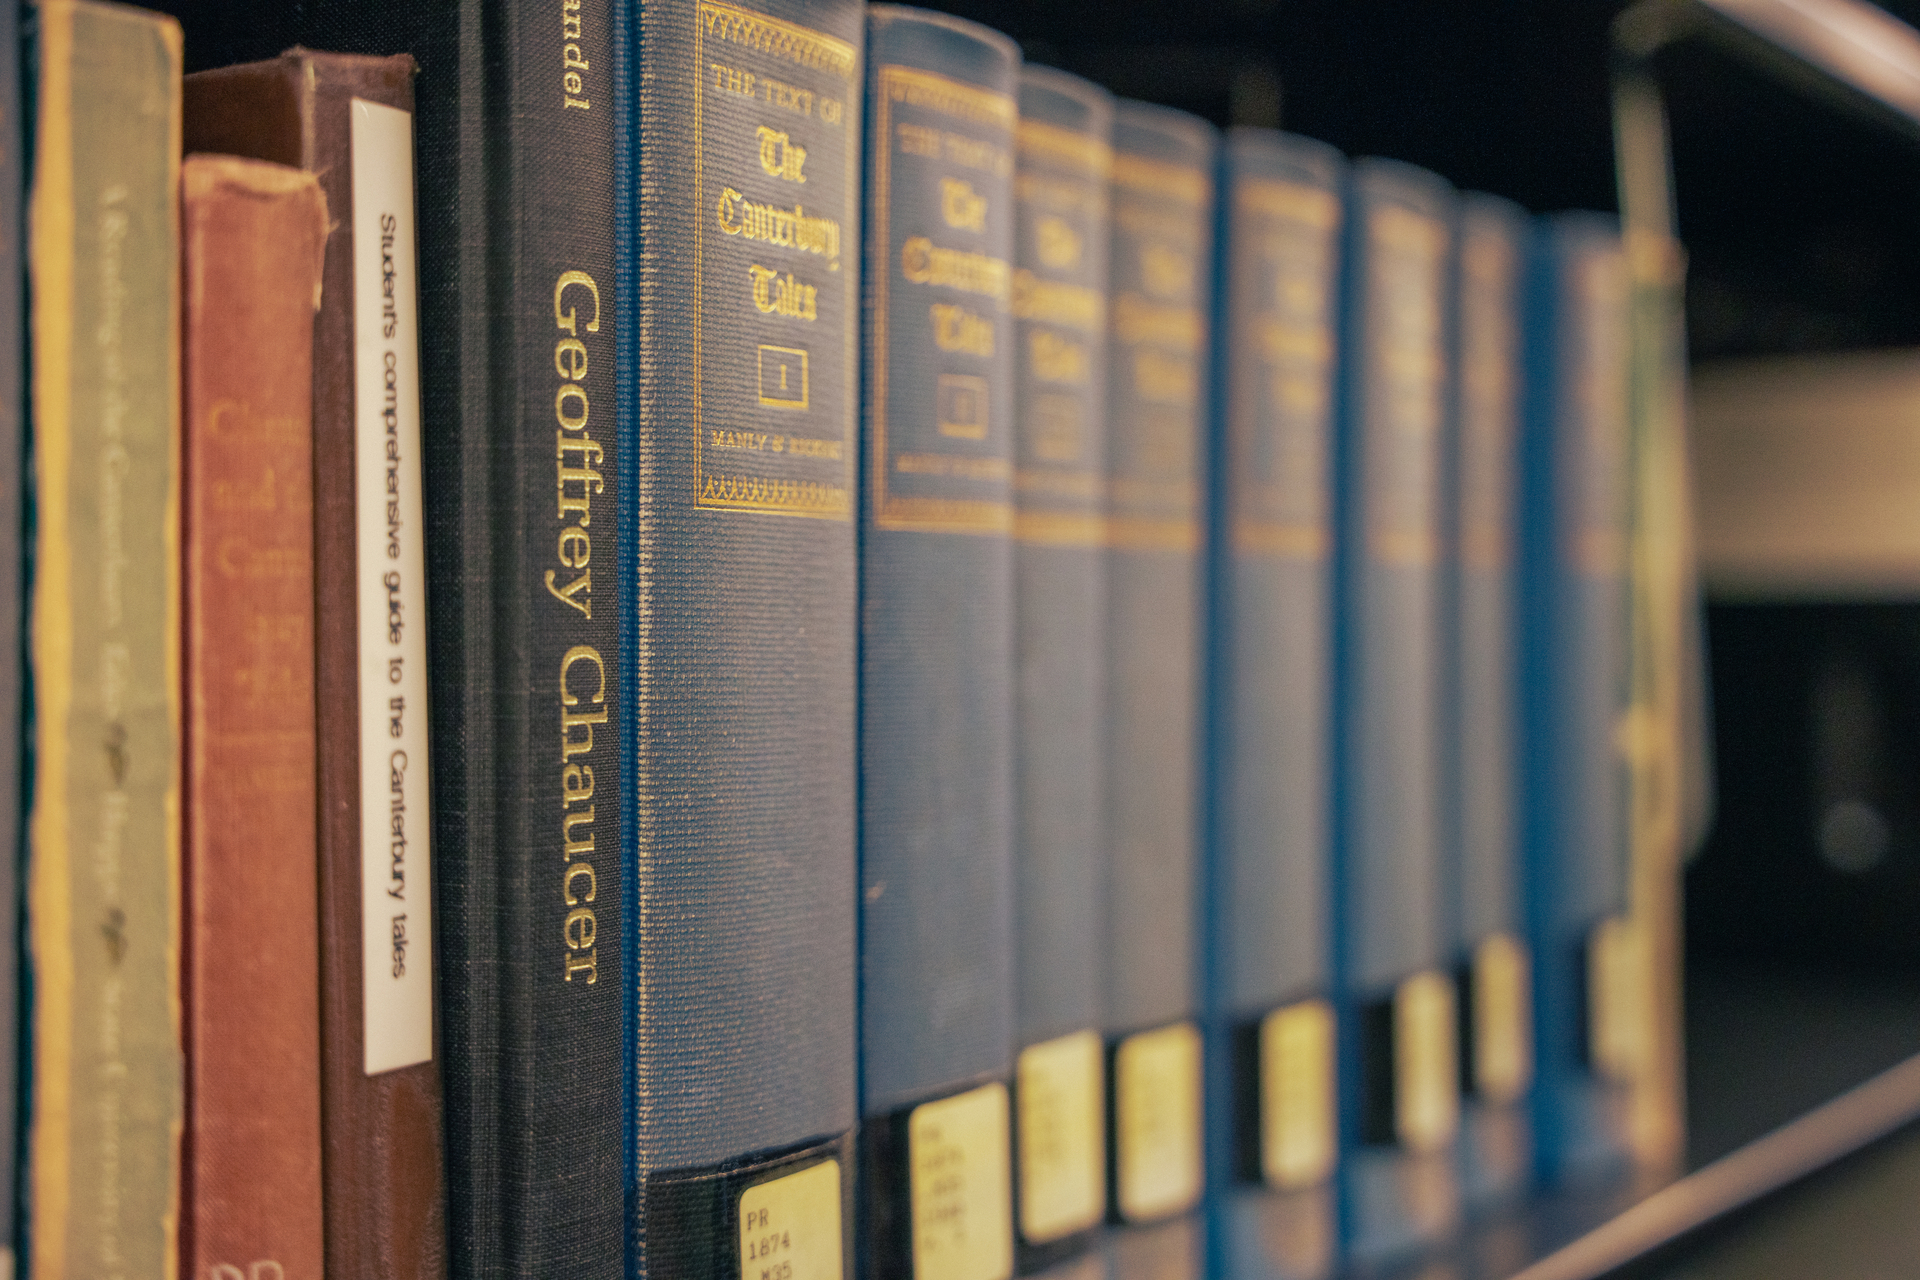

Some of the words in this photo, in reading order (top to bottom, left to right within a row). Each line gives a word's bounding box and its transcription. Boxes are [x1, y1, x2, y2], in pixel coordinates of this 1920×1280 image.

[711, 63, 756, 98] THE
[762, 77, 815, 117] TEXT
[756, 124, 807, 184] The
[381, 213, 398, 340] Student's
[749, 263, 818, 323] Tales
[381, 350, 403, 560] comprehensive
[545, 270, 604, 620] Geoffrey
[711, 429, 768, 451] MANLY
[383, 571, 405, 646] guide
[389, 656, 404, 685] to
[389, 696, 406, 739] the
[387, 749, 408, 901] Canterbury
[560, 644, 609, 986] Chaucer
[391, 912, 408, 980] tales
[746, 1207, 770, 1232] PR
[748, 1230, 791, 1261] 1874
